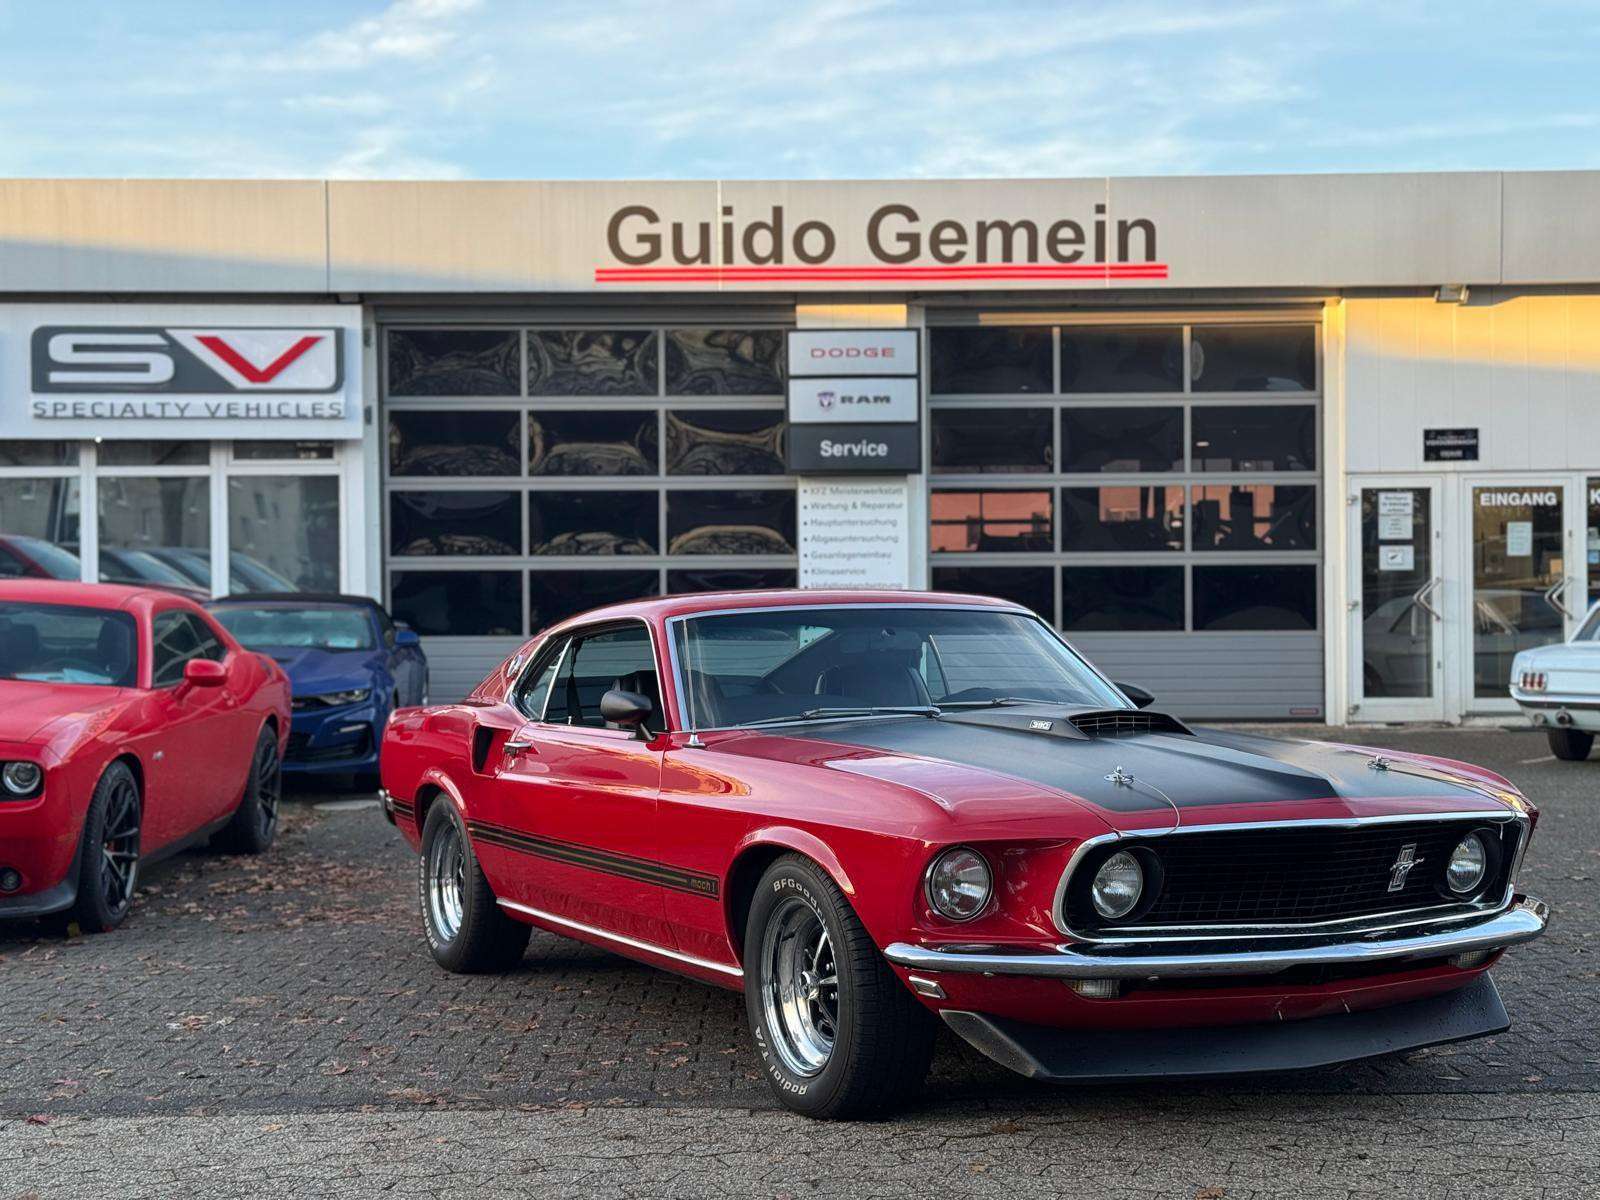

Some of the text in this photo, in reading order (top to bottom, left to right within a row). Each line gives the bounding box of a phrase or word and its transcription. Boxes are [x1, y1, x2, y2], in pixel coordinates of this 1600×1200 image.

[606, 204, 1158, 265] Guido Gemein
[48, 333, 326, 384] SV
[810, 348, 895, 358] DODGE
[840, 395, 891, 404] RAM
[33, 401, 343, 418] SPECIALTY VEHICLES
[820, 439, 888, 457] Service
[1480, 491, 1557, 507] EINGANG
[810, 501, 903, 512] Wartung & Reparatur
[810, 518, 899, 528] Hauptuntersuchung
[810, 534, 900, 544] Abgasuntersuchung
